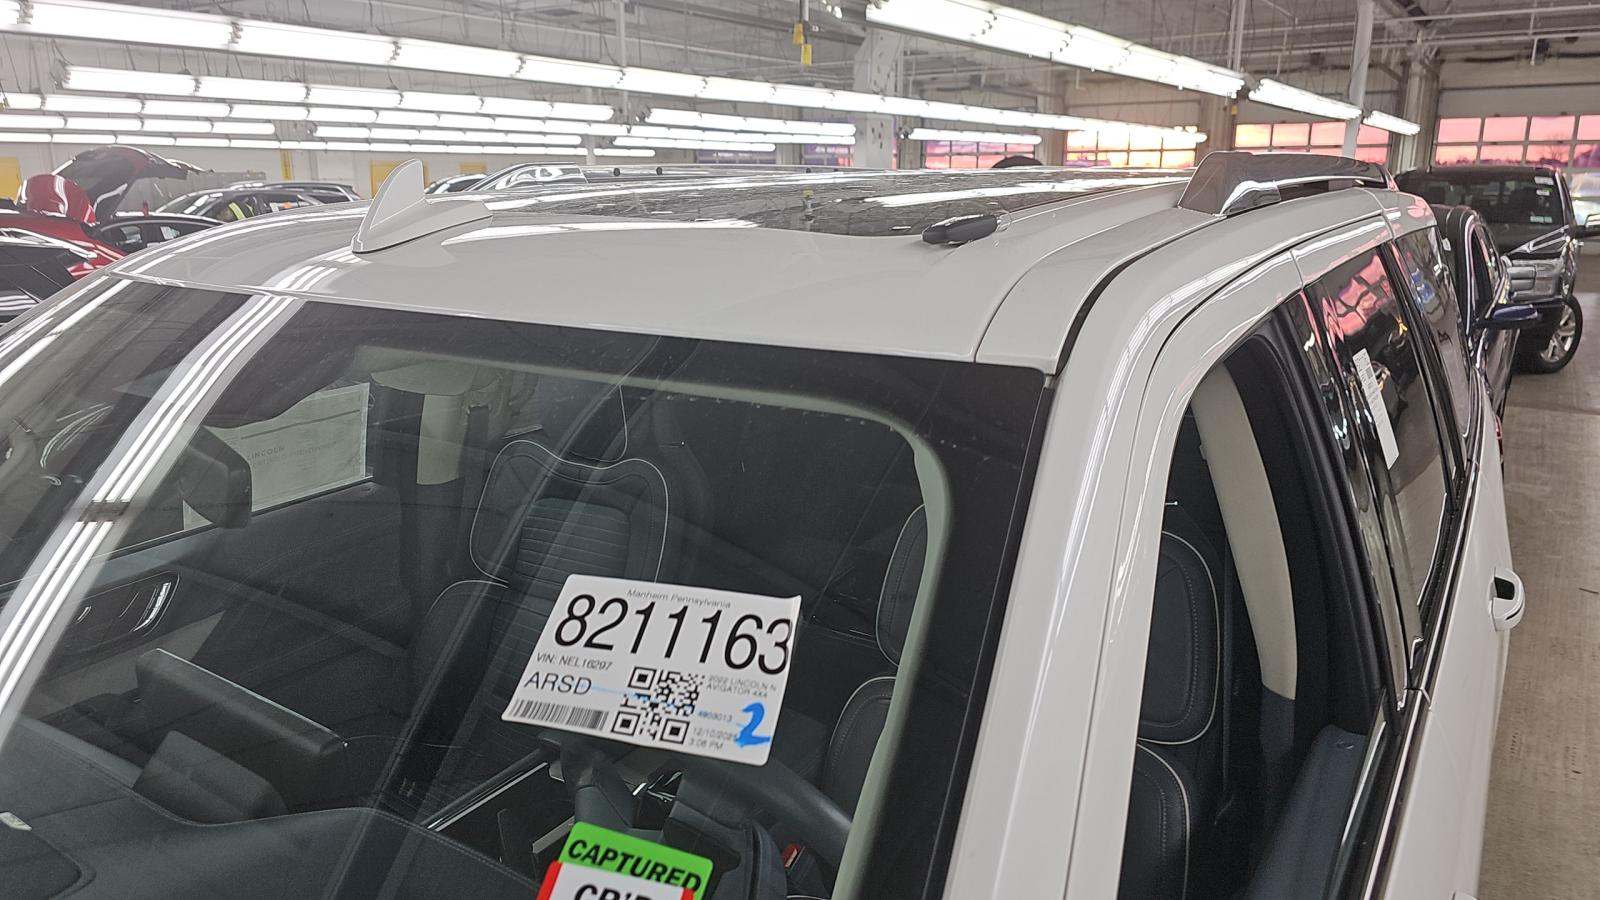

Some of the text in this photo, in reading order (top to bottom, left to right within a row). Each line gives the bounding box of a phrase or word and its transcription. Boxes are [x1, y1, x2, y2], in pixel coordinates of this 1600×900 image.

[627, 589, 732, 609] Manheim Pennsylvania
[554, 593, 791, 675] 8211163
[537, 652, 614, 671] VIN: NEL16297
[523, 670, 593, 695] ARSD
[706, 683, 751, 695] AVIGATOR
[730, 678, 768, 690] LINCOLN
[735, 702, 771, 748] 2
[568, 839, 701, 893] CAPTURED
